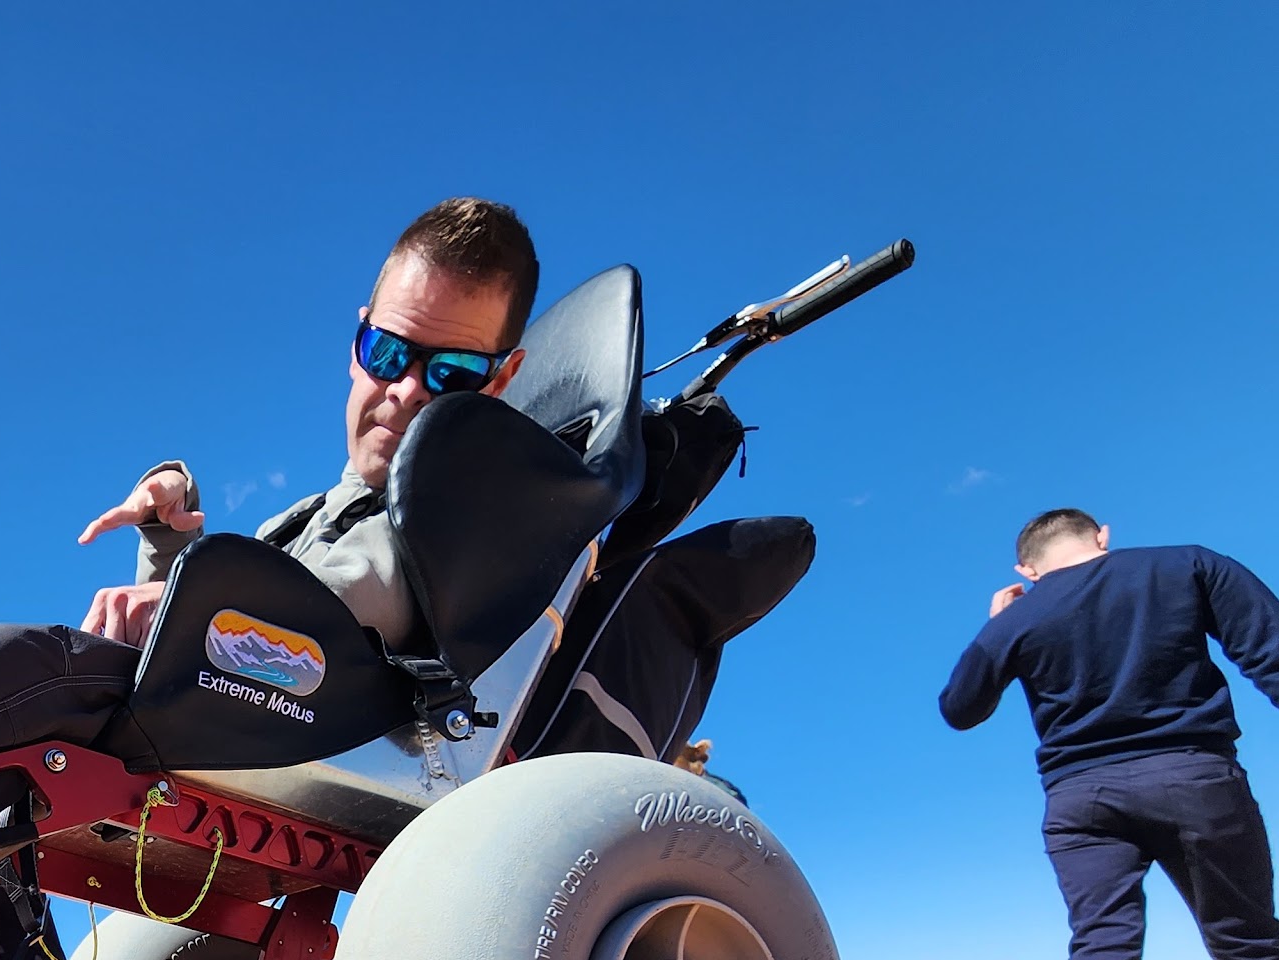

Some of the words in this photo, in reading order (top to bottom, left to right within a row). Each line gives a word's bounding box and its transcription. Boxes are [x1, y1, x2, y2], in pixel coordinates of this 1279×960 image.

[198, 671, 266, 705] Extreme
[267, 691, 316, 724] Motus
[560, 848, 599, 894] COMBO
